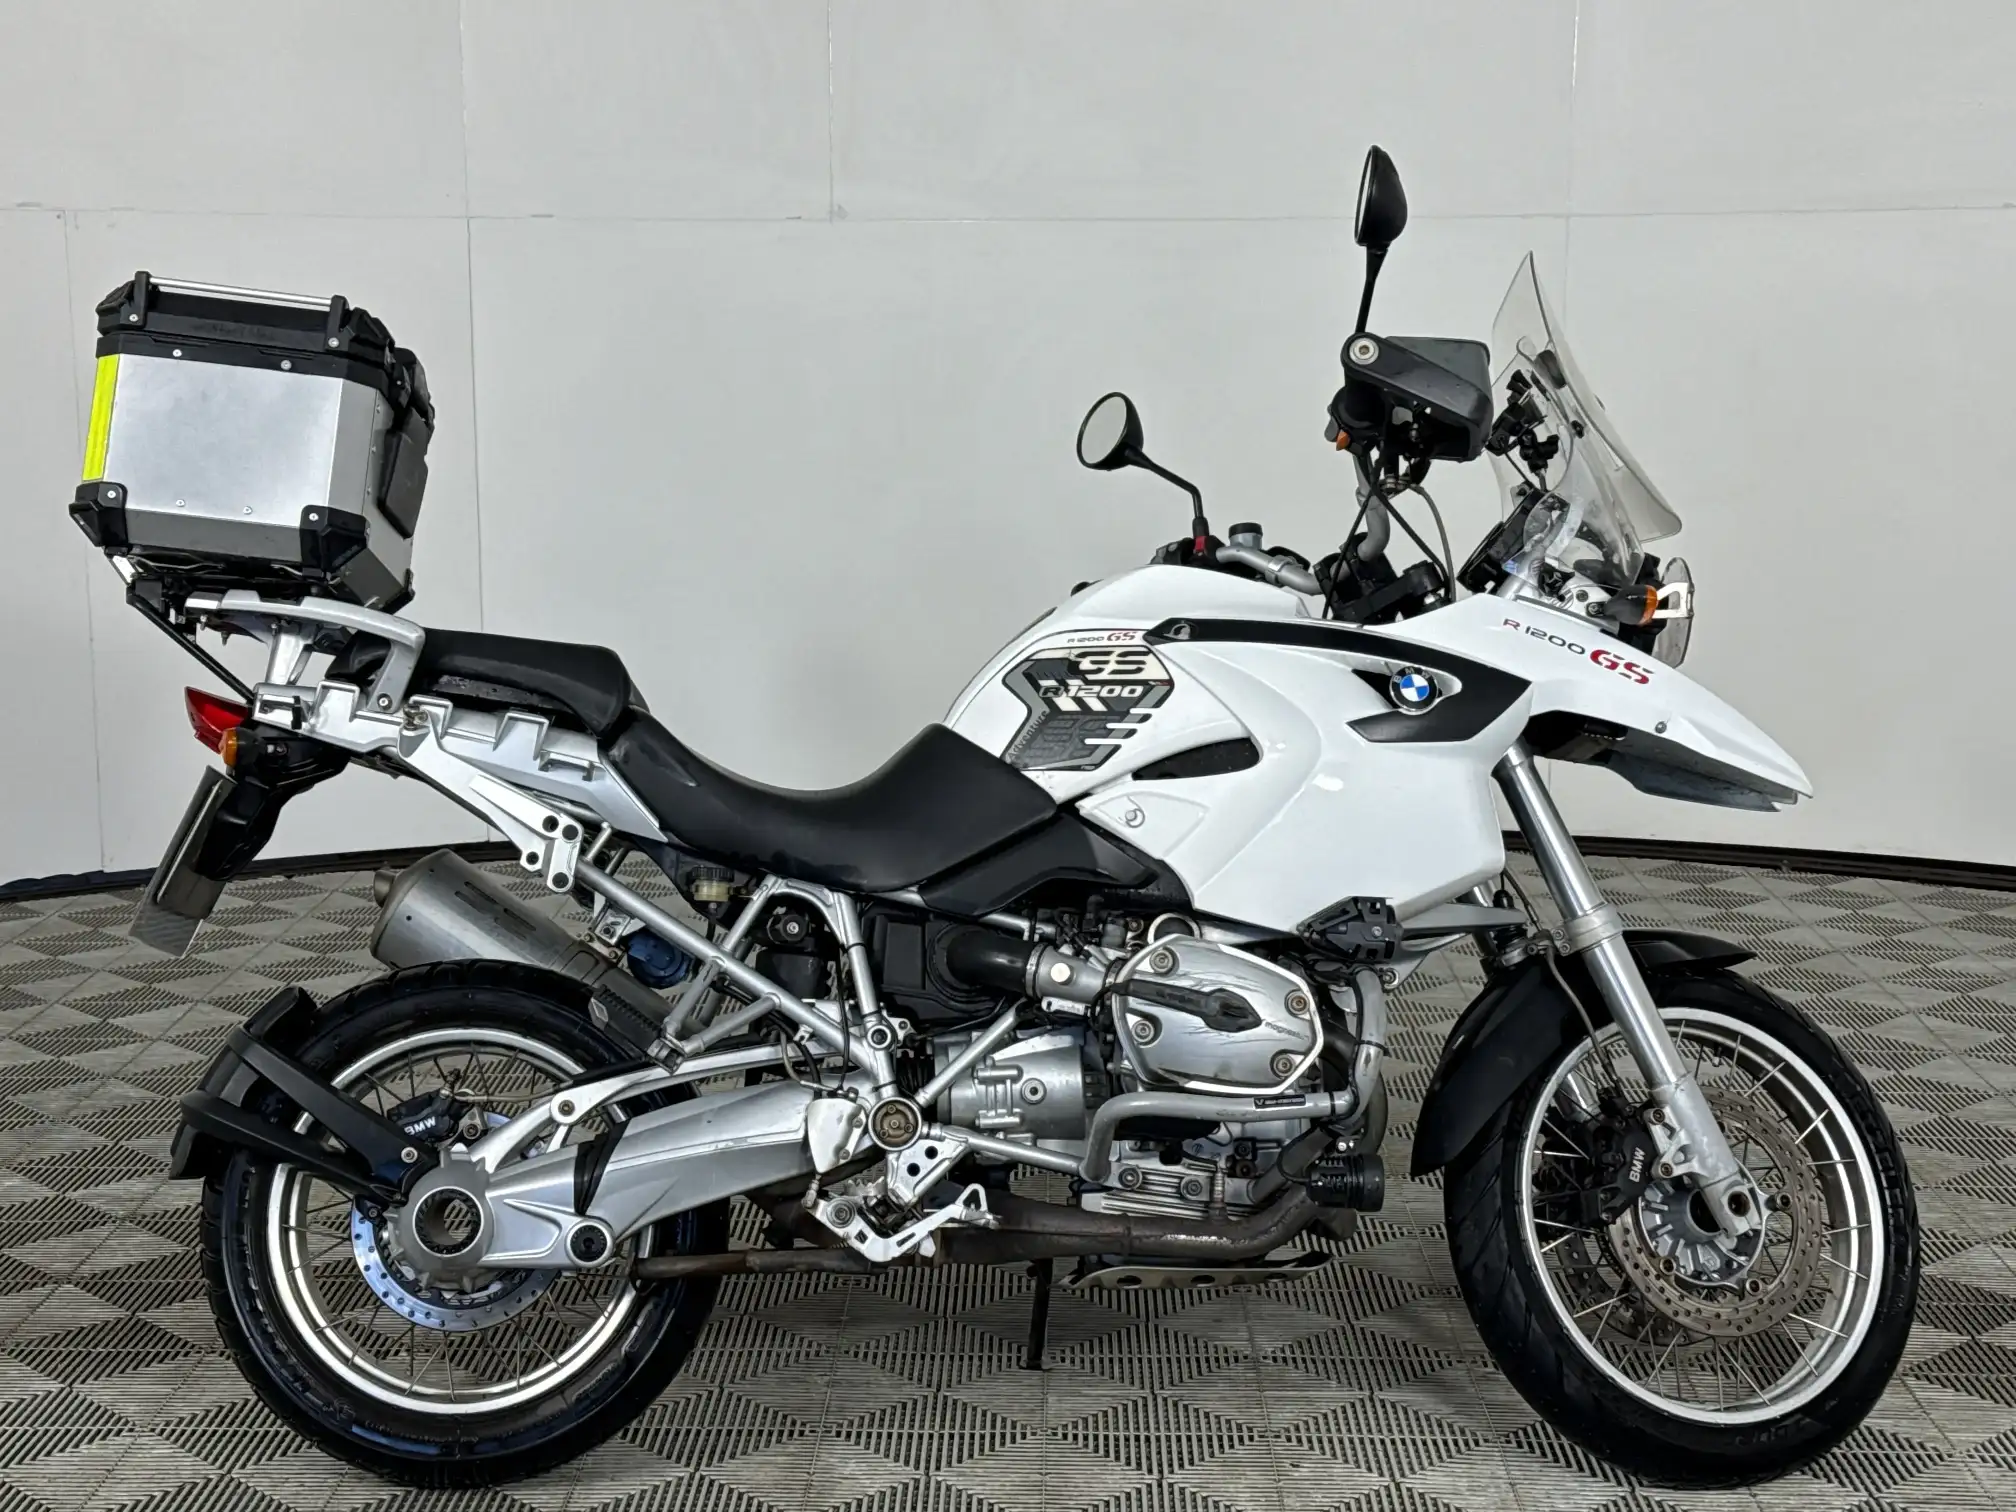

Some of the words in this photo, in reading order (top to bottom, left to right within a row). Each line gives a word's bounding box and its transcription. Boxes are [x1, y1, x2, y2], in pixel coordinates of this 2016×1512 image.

[1106, 631, 1138, 641] GS
[1502, 618, 1521, 631] R
[1525, 625, 1586, 655] 1200
[1589, 649, 1655, 685] GS
[1392, 666, 1432, 684] BMW
[1009, 710, 1048, 758] Adventure
[403, 1116, 437, 1136] BMW
[1628, 1147, 1646, 1183] BMW
